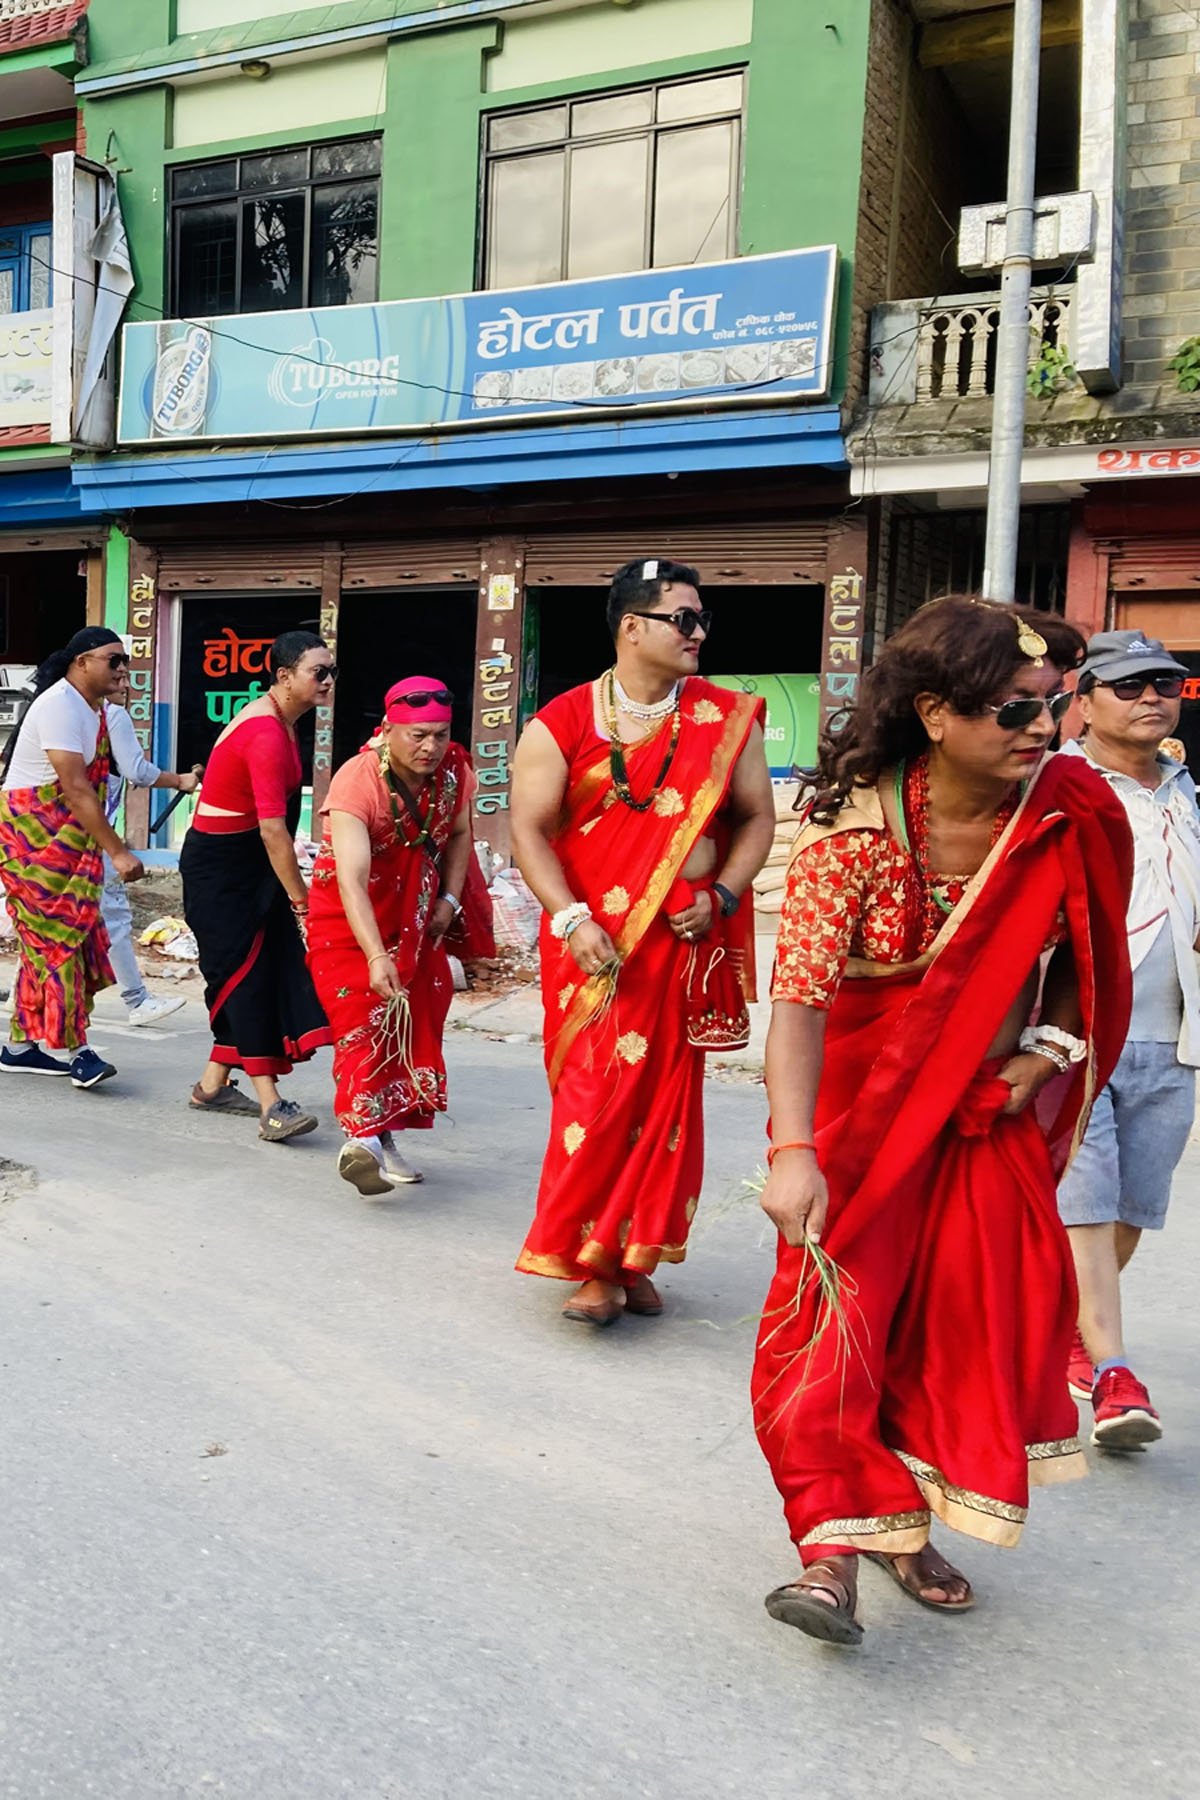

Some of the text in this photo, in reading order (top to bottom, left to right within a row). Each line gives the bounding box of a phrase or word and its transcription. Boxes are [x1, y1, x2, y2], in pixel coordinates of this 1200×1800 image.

[476, 287, 723, 359] होटल पर्वत
[157, 351, 204, 423] TUBORG
[289, 354, 400, 392] TUBORG
[335, 390, 358, 400] OPEN
[131, 574, 155, 659] होटल
[203, 628, 276, 677] होट
[829, 567, 863, 667] होटल
